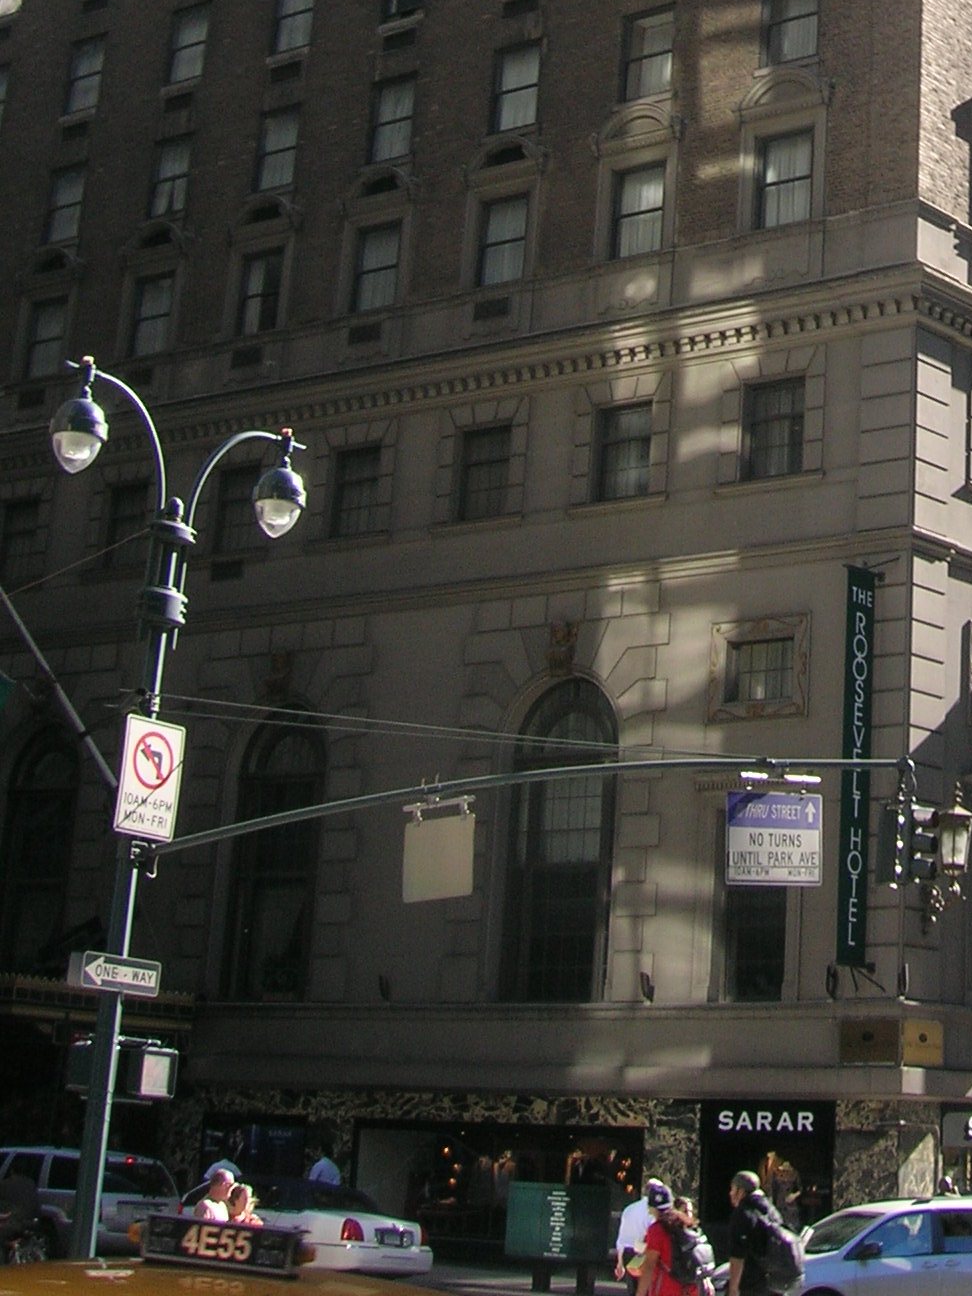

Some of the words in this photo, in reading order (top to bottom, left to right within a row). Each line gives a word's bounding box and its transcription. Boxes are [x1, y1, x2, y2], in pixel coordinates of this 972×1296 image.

[852, 586, 872, 607] THE
[745, 803, 770, 819] THRU
[771, 804, 802, 820] STREET
[749, 832, 764, 846] NO
[768, 833, 802, 848] TURNS
[732, 851, 762, 865] UNTIL
[768, 851, 793, 865] PARK
[799, 851, 817, 865] AVE
[847, 827, 862, 945] HOTEL
[95, 964, 118, 979] ONE
[131, 969, 154, 984] WAY
[718, 1110, 814, 1132] SARAR
[181, 1224, 253, 1262] 4E55
